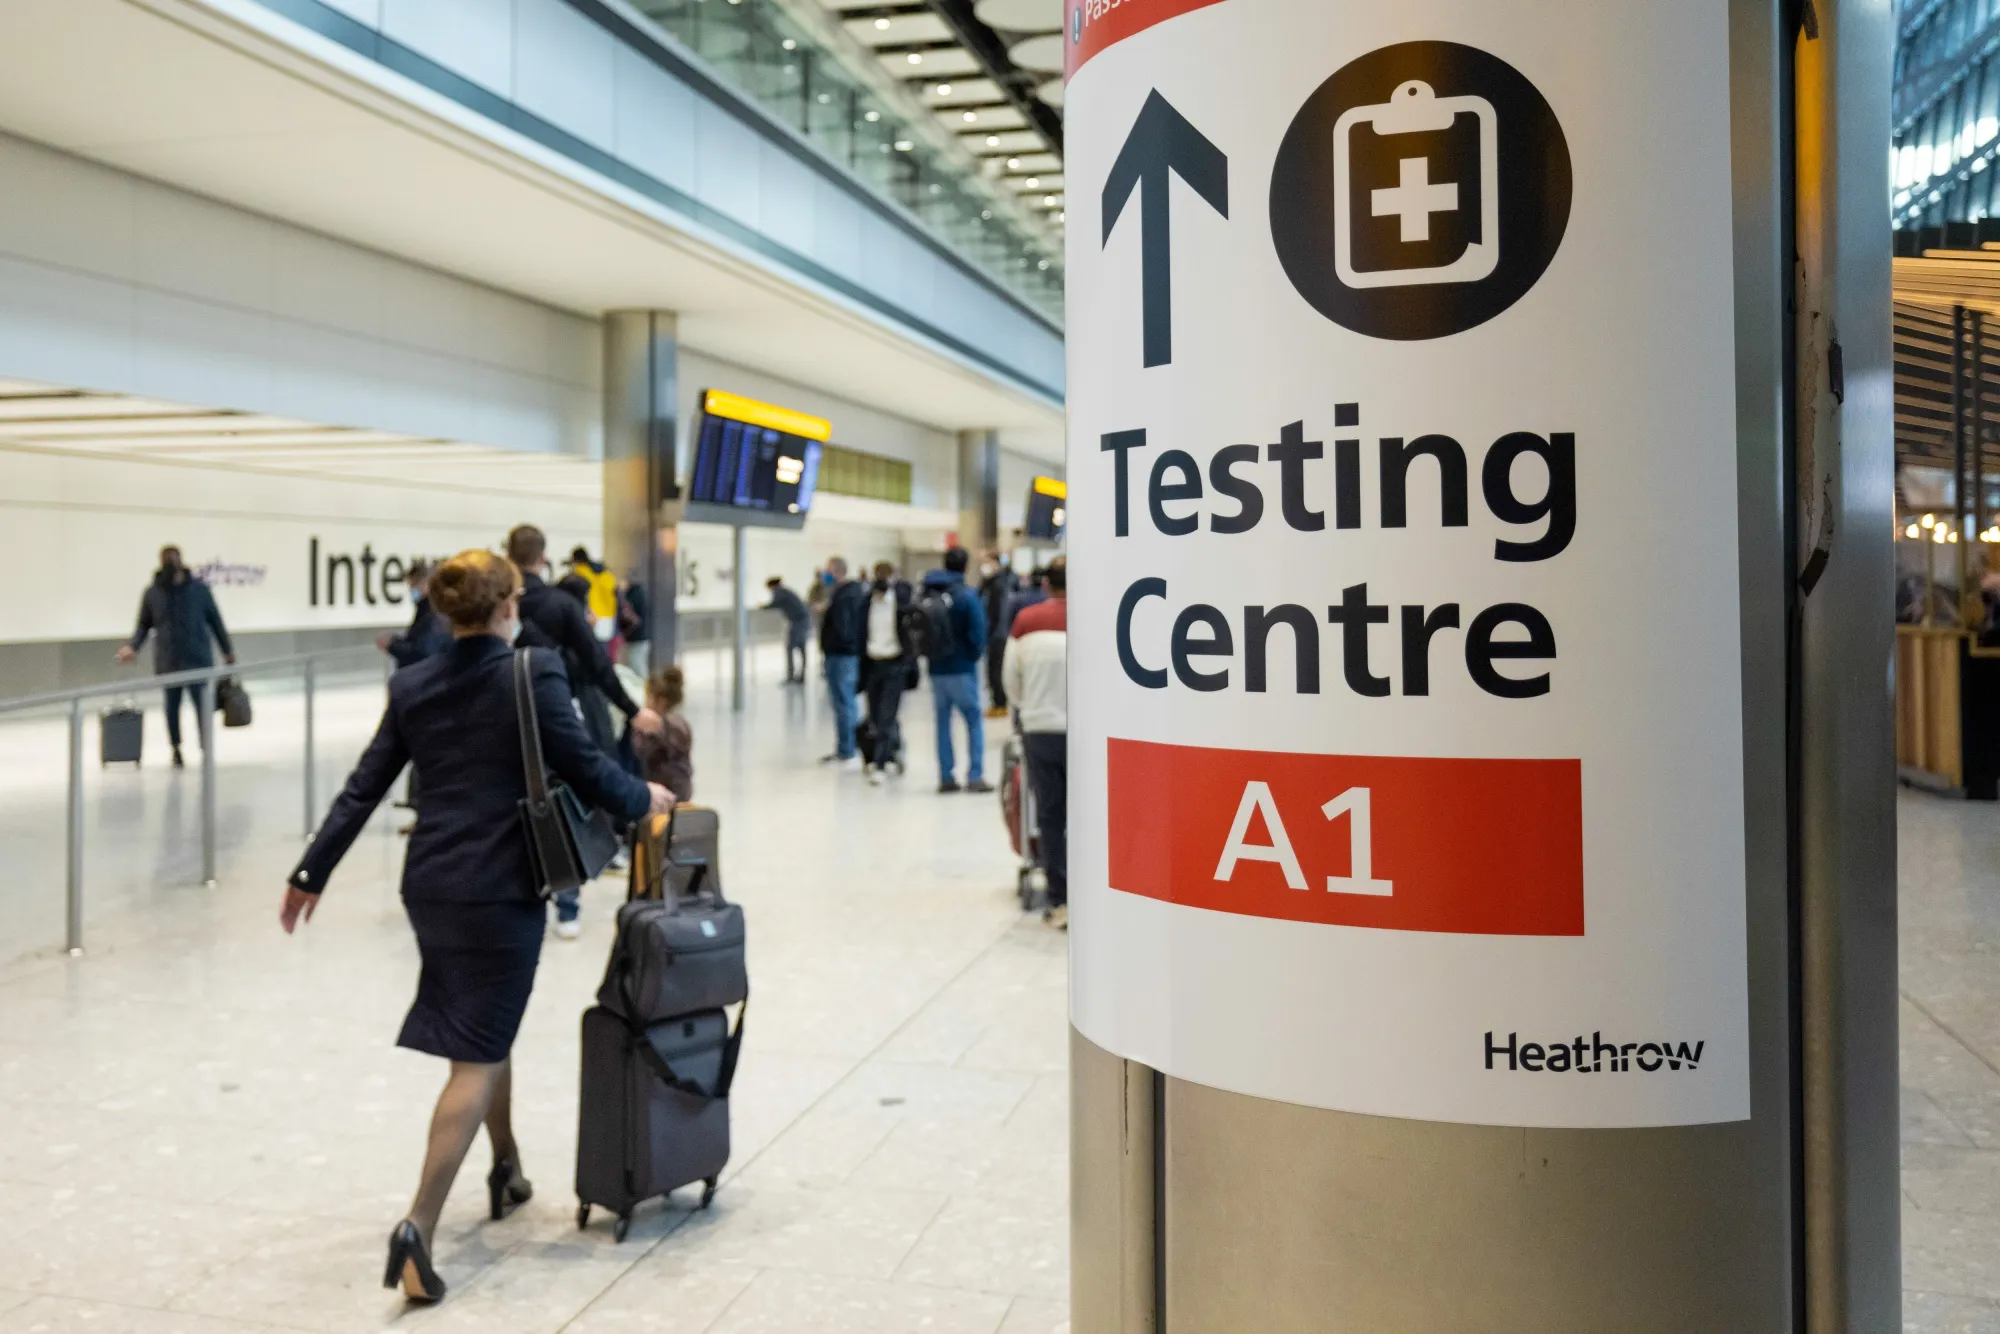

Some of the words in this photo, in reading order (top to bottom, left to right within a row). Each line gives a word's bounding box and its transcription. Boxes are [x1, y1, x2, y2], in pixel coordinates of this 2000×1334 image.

[1100, 402, 1577, 562] Testing
[1116, 576, 1557, 699] Centre
[1213, 780, 1394, 897] A1
[1484, 1030, 1705, 1074] Heathrow
